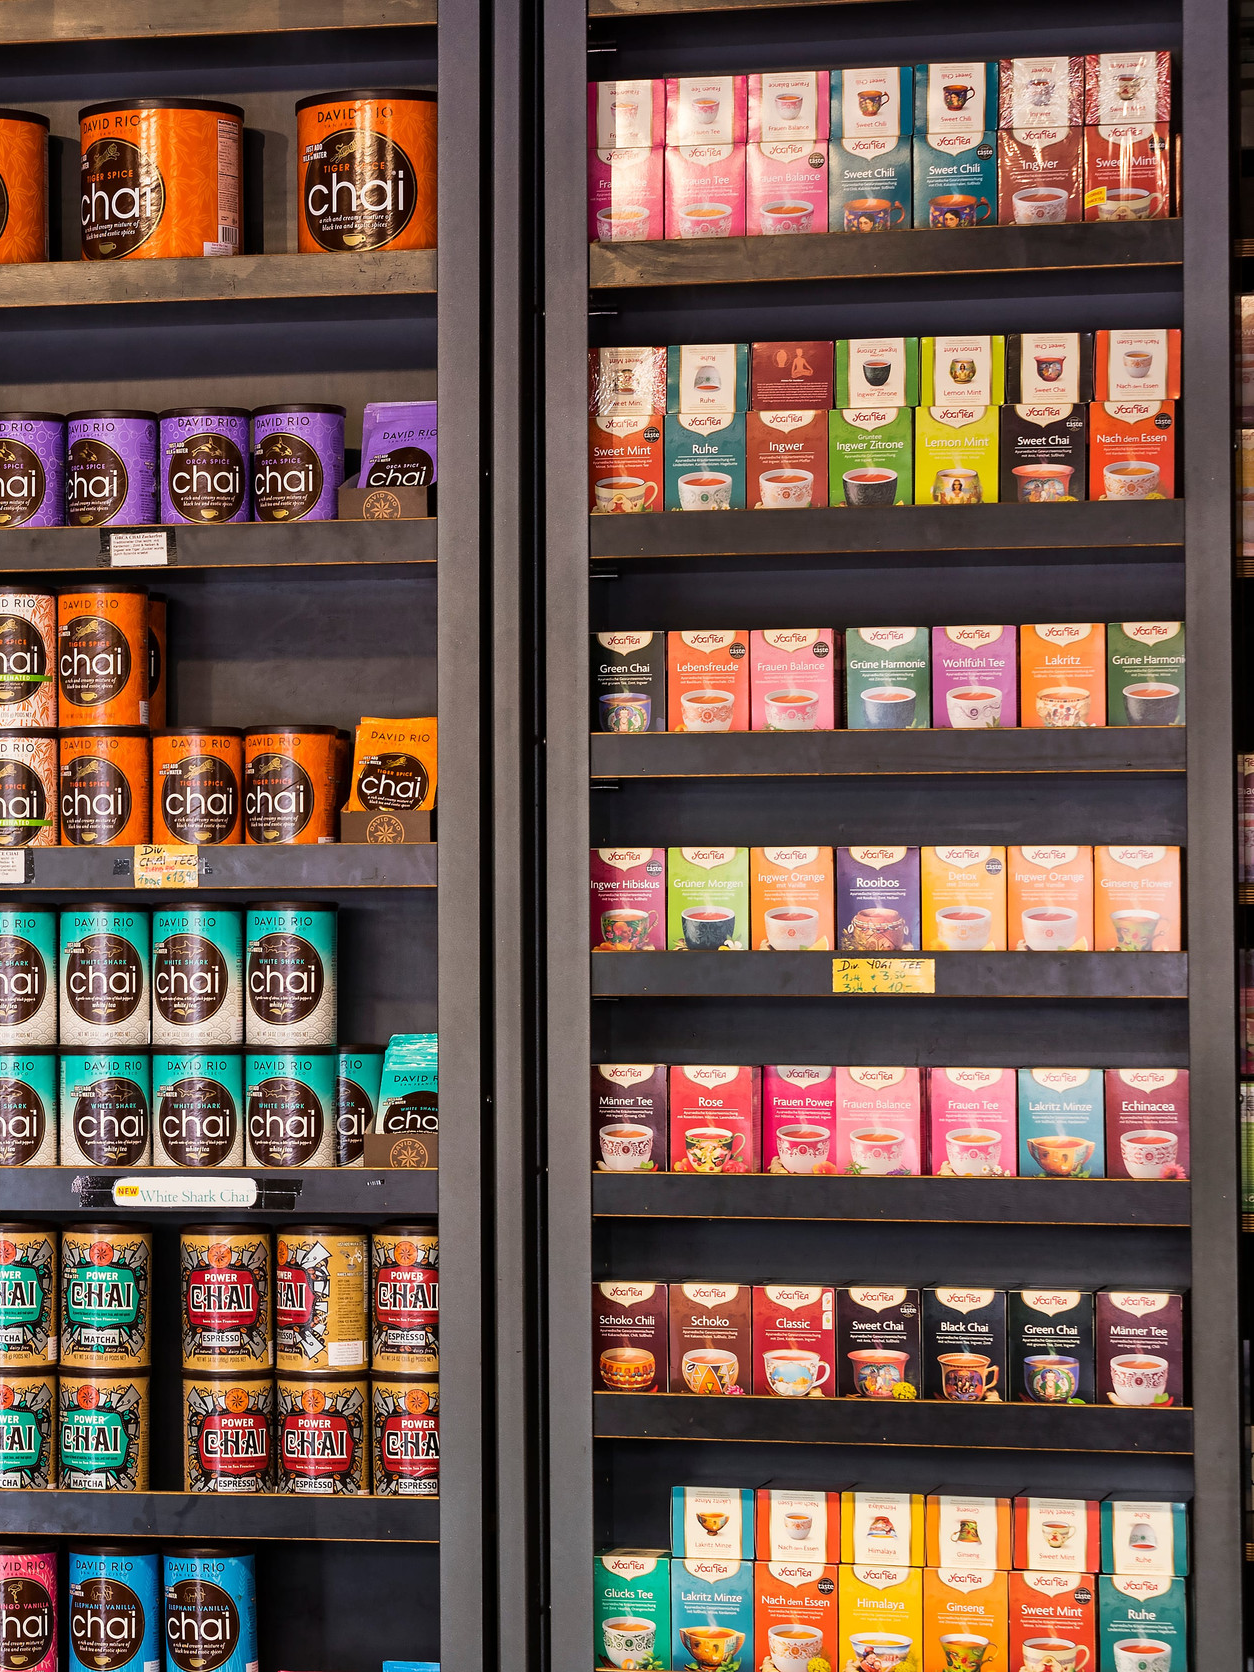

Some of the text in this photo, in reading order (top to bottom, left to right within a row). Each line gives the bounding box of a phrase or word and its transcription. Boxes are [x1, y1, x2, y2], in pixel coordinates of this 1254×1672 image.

[87, 170, 133, 182] TIGER SPICE
[844, 167, 895, 179] Sweet Chili
[83, 179, 151, 224] chai
[925, 436, 989, 448] Lemon Mint
[1097, 434, 1118, 443] Nach
[1136, 433, 1166, 443] Essen
[692, 444, 718, 454] Ruhe
[836, 439, 904, 452] Ingwer Zitrone
[594, 446, 651, 457] Sweet Mint
[850, 658, 926, 670] Grüne Harmonie
[943, 657, 1002, 668] Wohlfühl Tee
[1045, 655, 1080, 666] Lakritz
[599, 662, 650, 673] Green Chai
[677, 661, 739, 673] Lebensfreude
[166, 785, 232, 815] chai
[590, 878, 660, 891] Ingwer Hibiskus
[856, 877, 899, 888] Rooibos
[254, 915, 313, 926] DAVID RIO
[70, 966, 137, 995] chai
[599, 1096, 653, 1107] Männer Tee
[699, 1096, 723, 1107] Rose
[773, 1096, 834, 1107] Frauen Power
[1029, 1101, 1092, 1112] Lakritz Minze
[1122, 1101, 1175, 1112] Echinacea
[117, 1187, 138, 1195] NEW
[141, 1189, 249, 1204] White Shark Chai
[599, 1315, 655, 1326] Schoko Chili
[776, 1317, 810, 1329] Classic
[941, 1321, 989, 1332] Black Chai
[202, 1333, 239, 1343] ESPRESSO
[605, 1588, 653, 1599] Glücks Tee
[74, 1603, 103, 1611] ELEPHANT
[857, 1598, 904, 1612] Himalaya
[946, 1603, 985, 1616] Ginseng
[73, 1612, 136, 1640] chai
